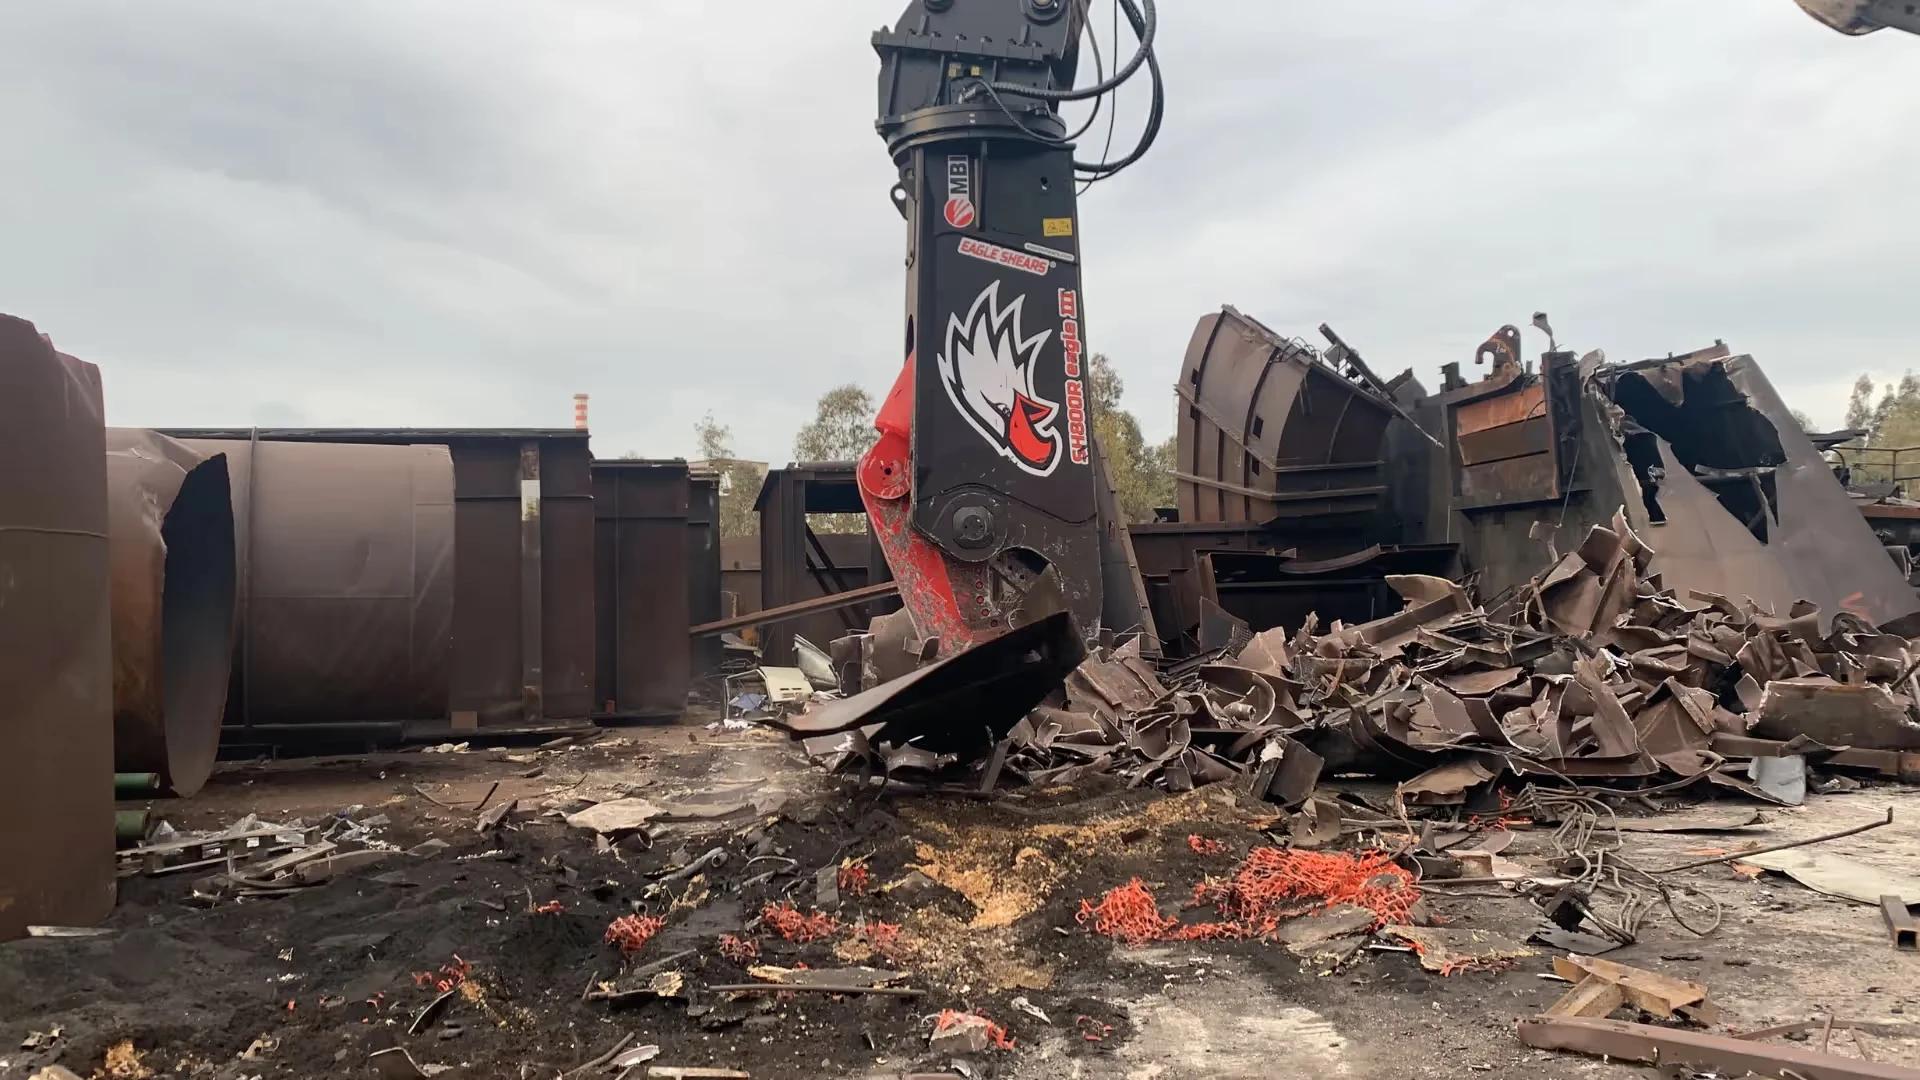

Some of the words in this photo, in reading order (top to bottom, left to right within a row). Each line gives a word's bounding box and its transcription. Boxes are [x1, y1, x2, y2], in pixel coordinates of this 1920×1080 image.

[950, 156, 968, 194] MBI
[961, 240, 999, 260] EAGLE
[1000, 250, 1048, 273] SHEARS
[1062, 321, 1080, 376] eagle
[1067, 381, 1088, 463] SH800R
